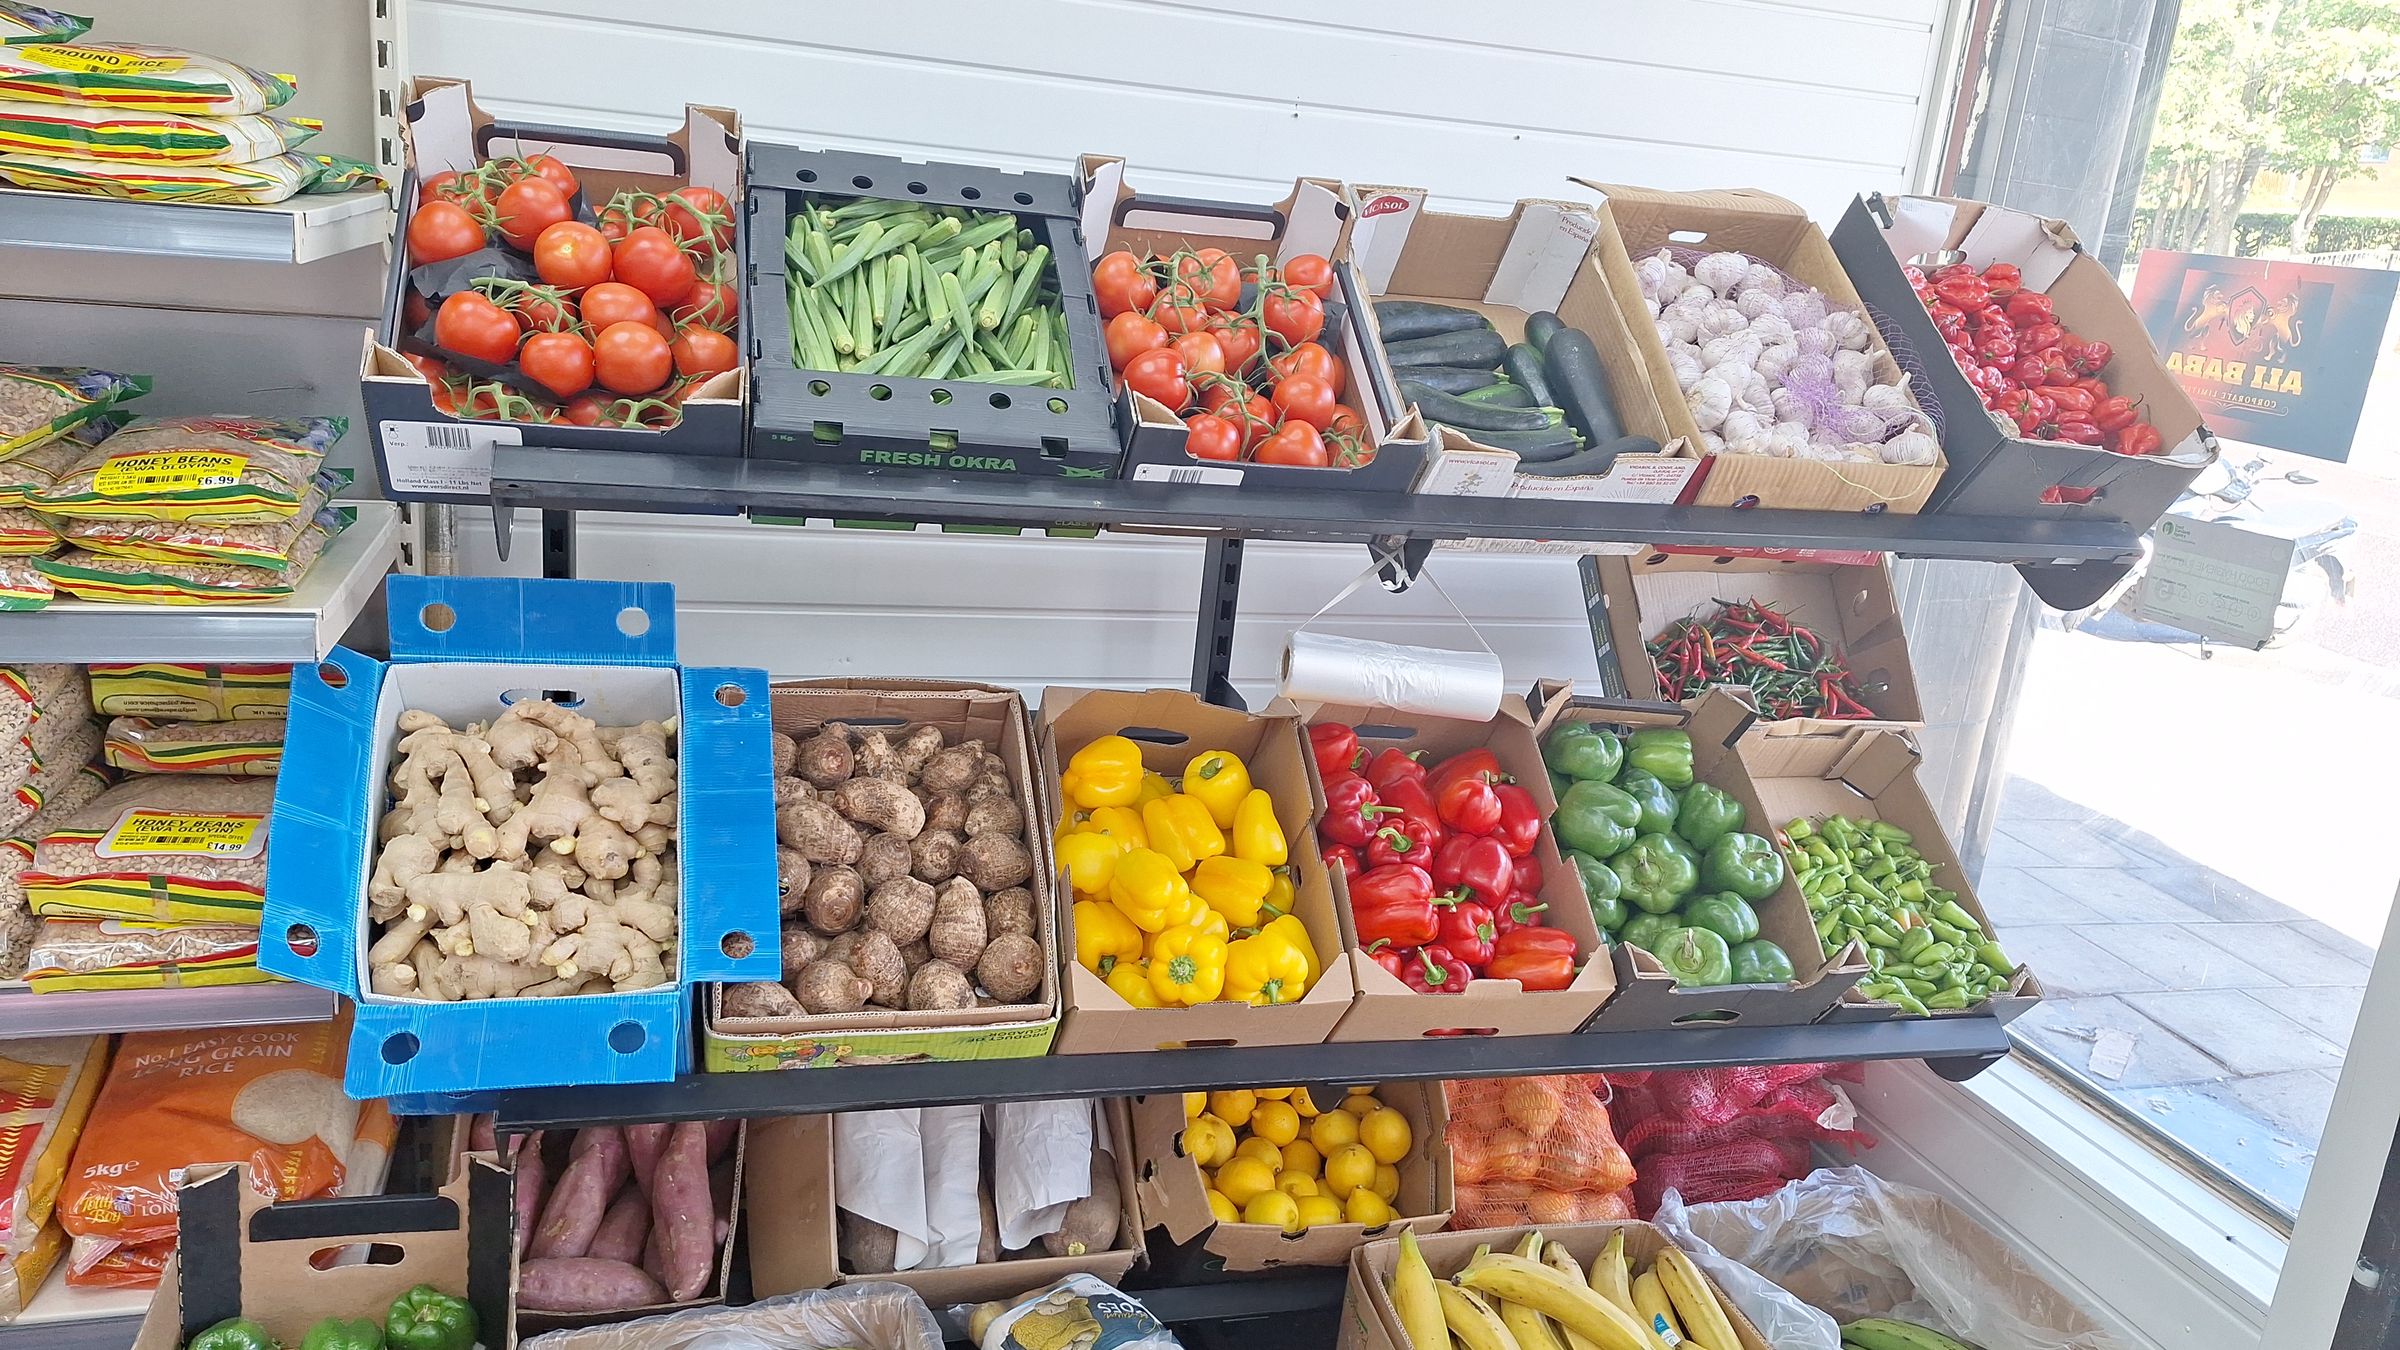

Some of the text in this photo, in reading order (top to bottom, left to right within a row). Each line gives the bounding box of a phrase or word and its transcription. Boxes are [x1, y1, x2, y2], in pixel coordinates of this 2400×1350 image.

[38, 47, 120, 66] GROUND
[114, 456, 232, 468] HONEY BEANS
[860, 449, 1018, 471] FRESH OKRA
[198, 476, 234, 486] £6.99
[206, 842, 242, 851] £14.99
[989, 1026, 1048, 1036] ECUADOR
[989, 1032, 1047, 1041] PRODUCT
[135, 1032, 300, 1068] No.1 EASY COOK
[211, 1045, 293, 1060] GRAIN
[179, 1061, 235, 1078] RICE
[142, 1204, 178, 1216] LON
